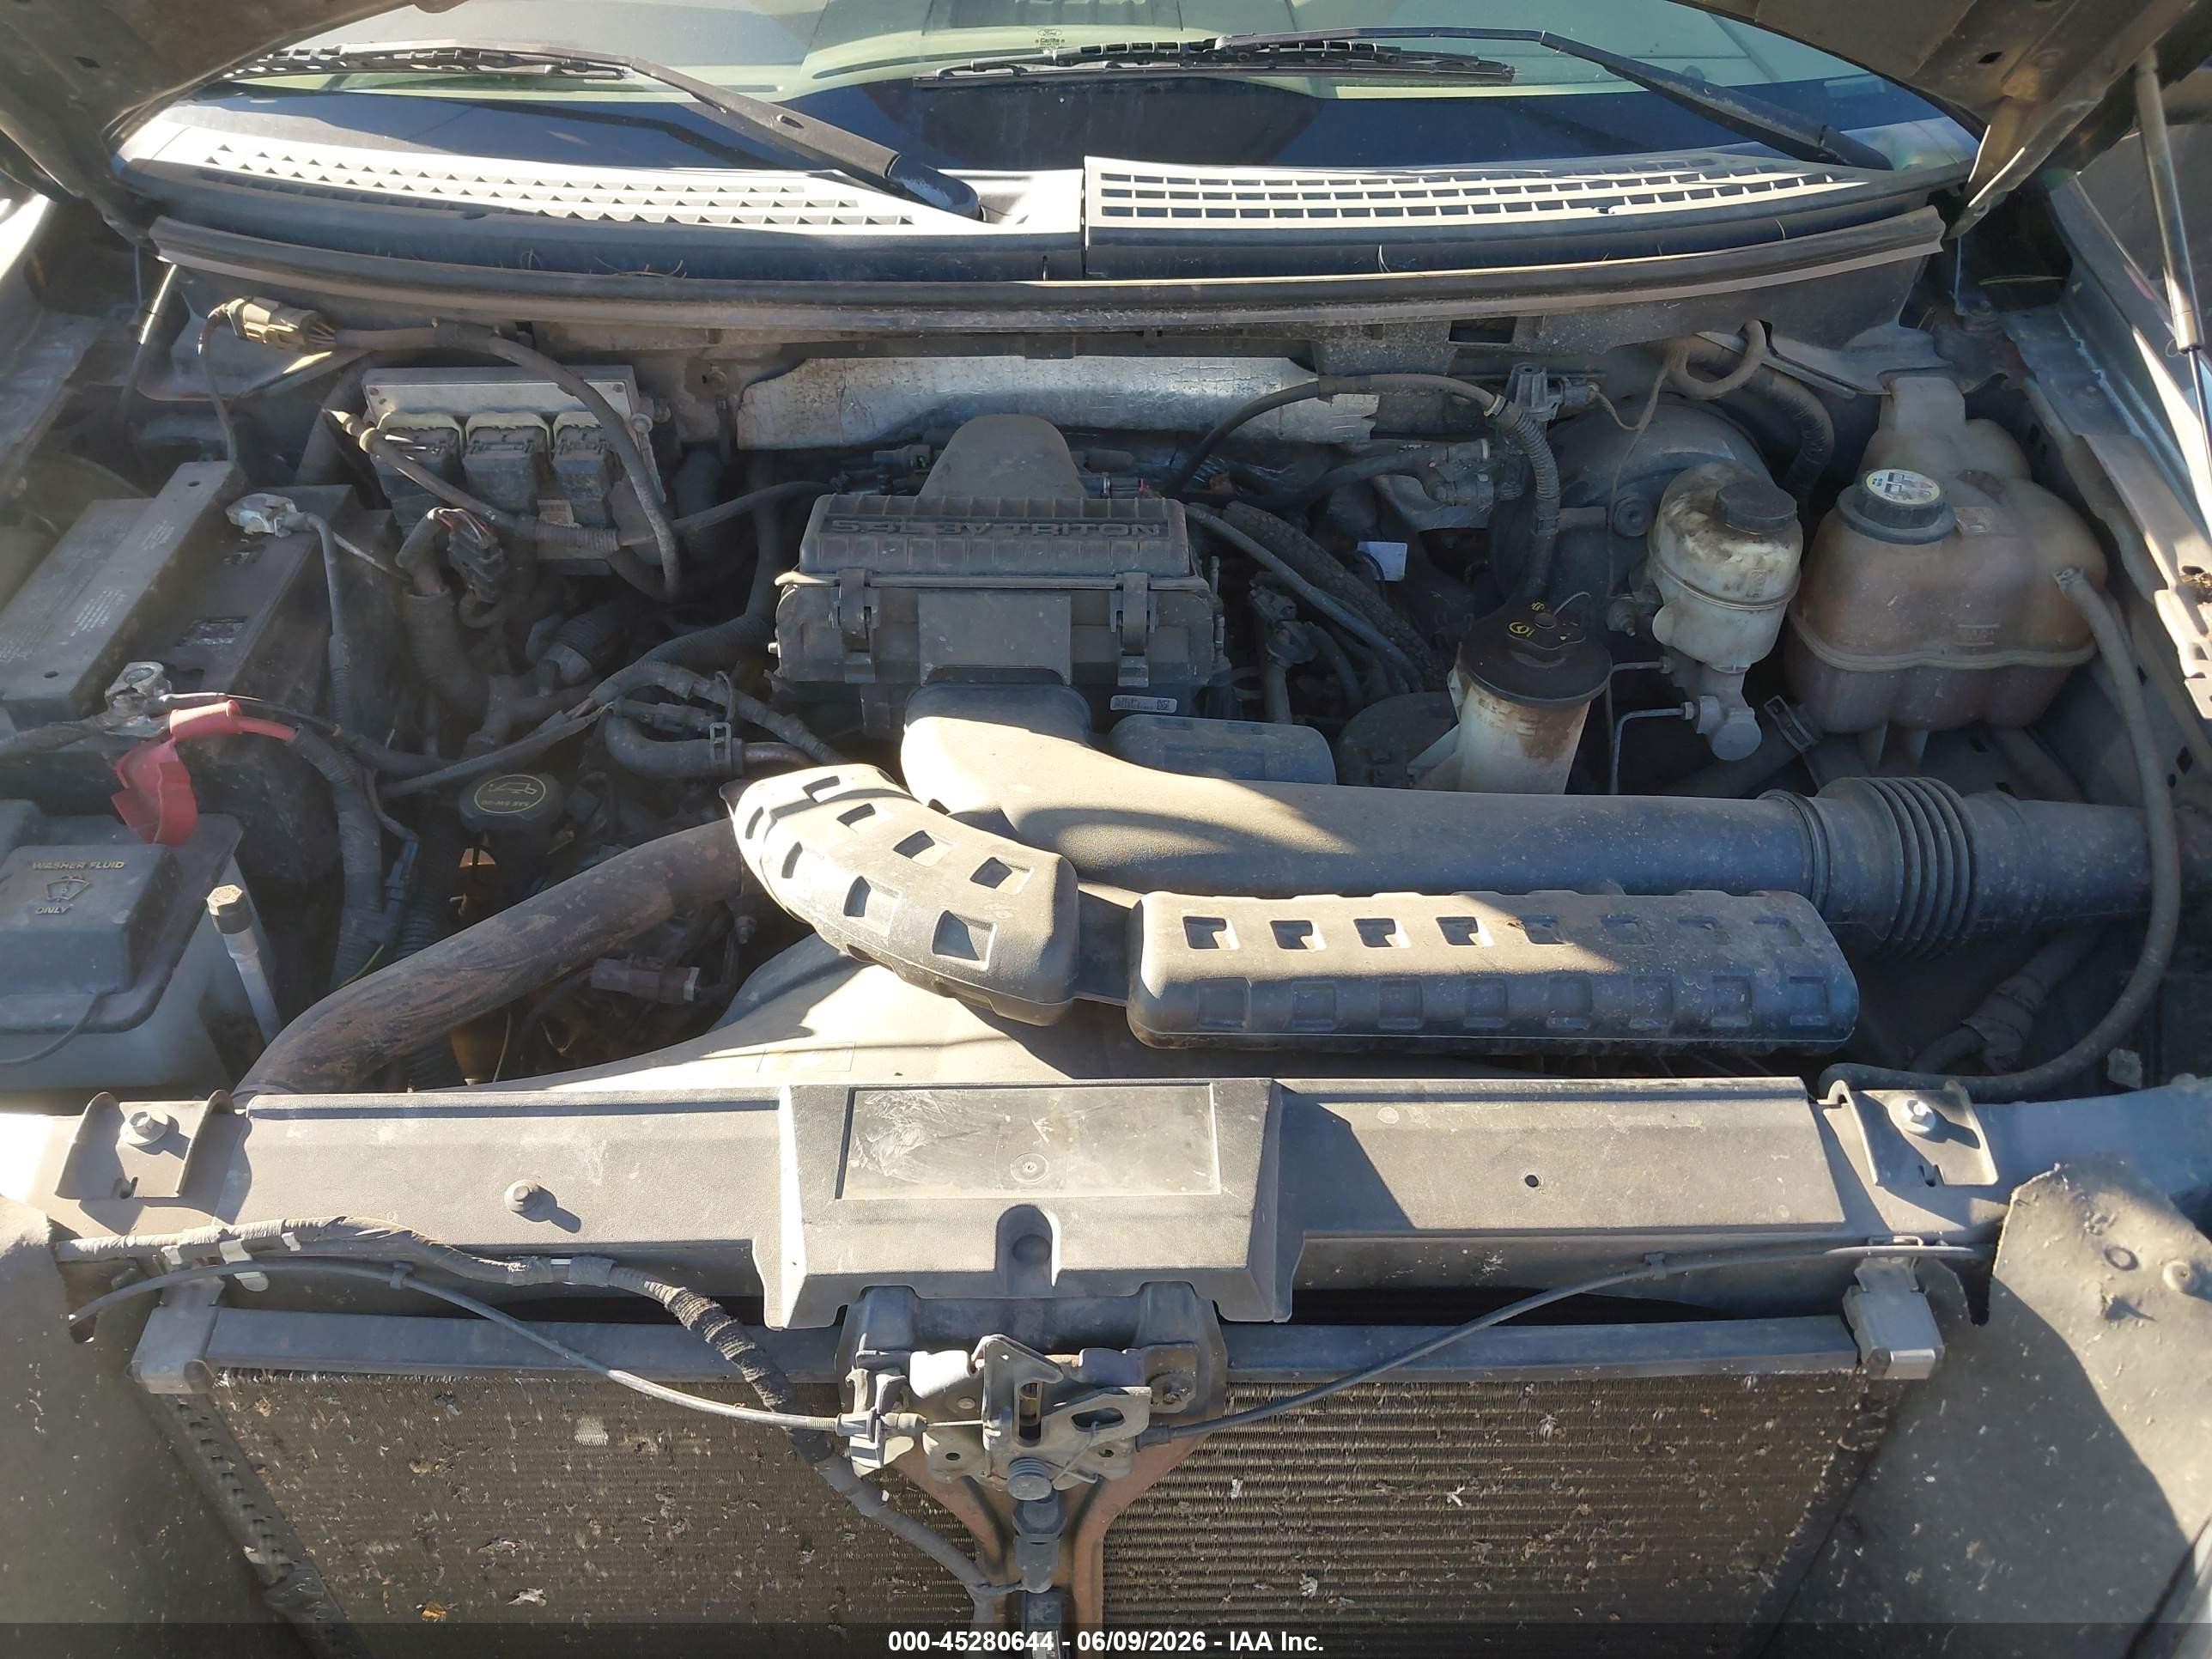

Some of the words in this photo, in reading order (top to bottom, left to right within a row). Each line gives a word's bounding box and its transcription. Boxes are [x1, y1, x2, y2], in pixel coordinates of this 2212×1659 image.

[831, 519, 921, 535] 5.4L
[935, 520, 994, 537] 3V
[1003, 522, 1160, 538] TRITON
[33, 861, 85, 871] WASHER
[88, 860, 125, 870] FLUID
[34, 904, 70, 915] ONLY
